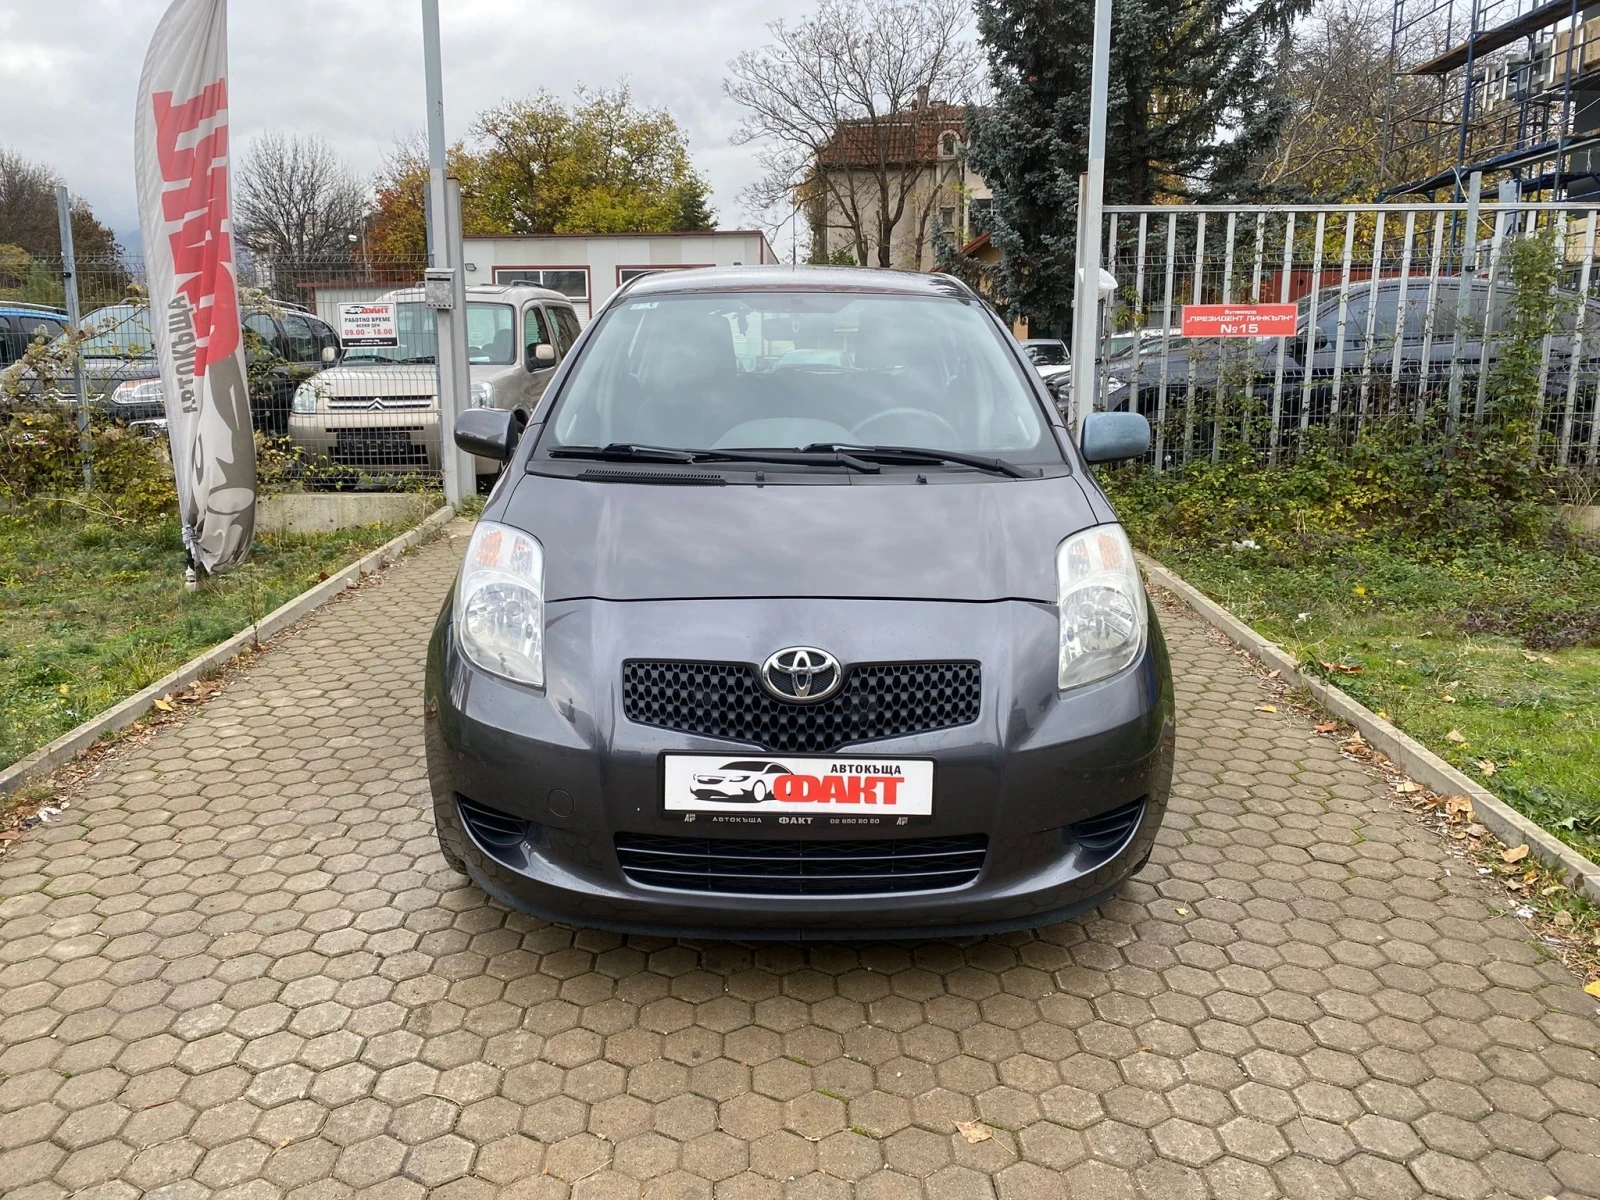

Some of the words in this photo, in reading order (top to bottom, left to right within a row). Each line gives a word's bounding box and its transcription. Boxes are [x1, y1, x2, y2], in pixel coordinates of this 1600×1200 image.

[167, 294, 198, 415] АВТОКЪЩА
[830, 763, 902, 776] АВТОКЪЩА
[773, 774, 905, 805] ФАКТ
[778, 816, 813, 825] ФАКТ
